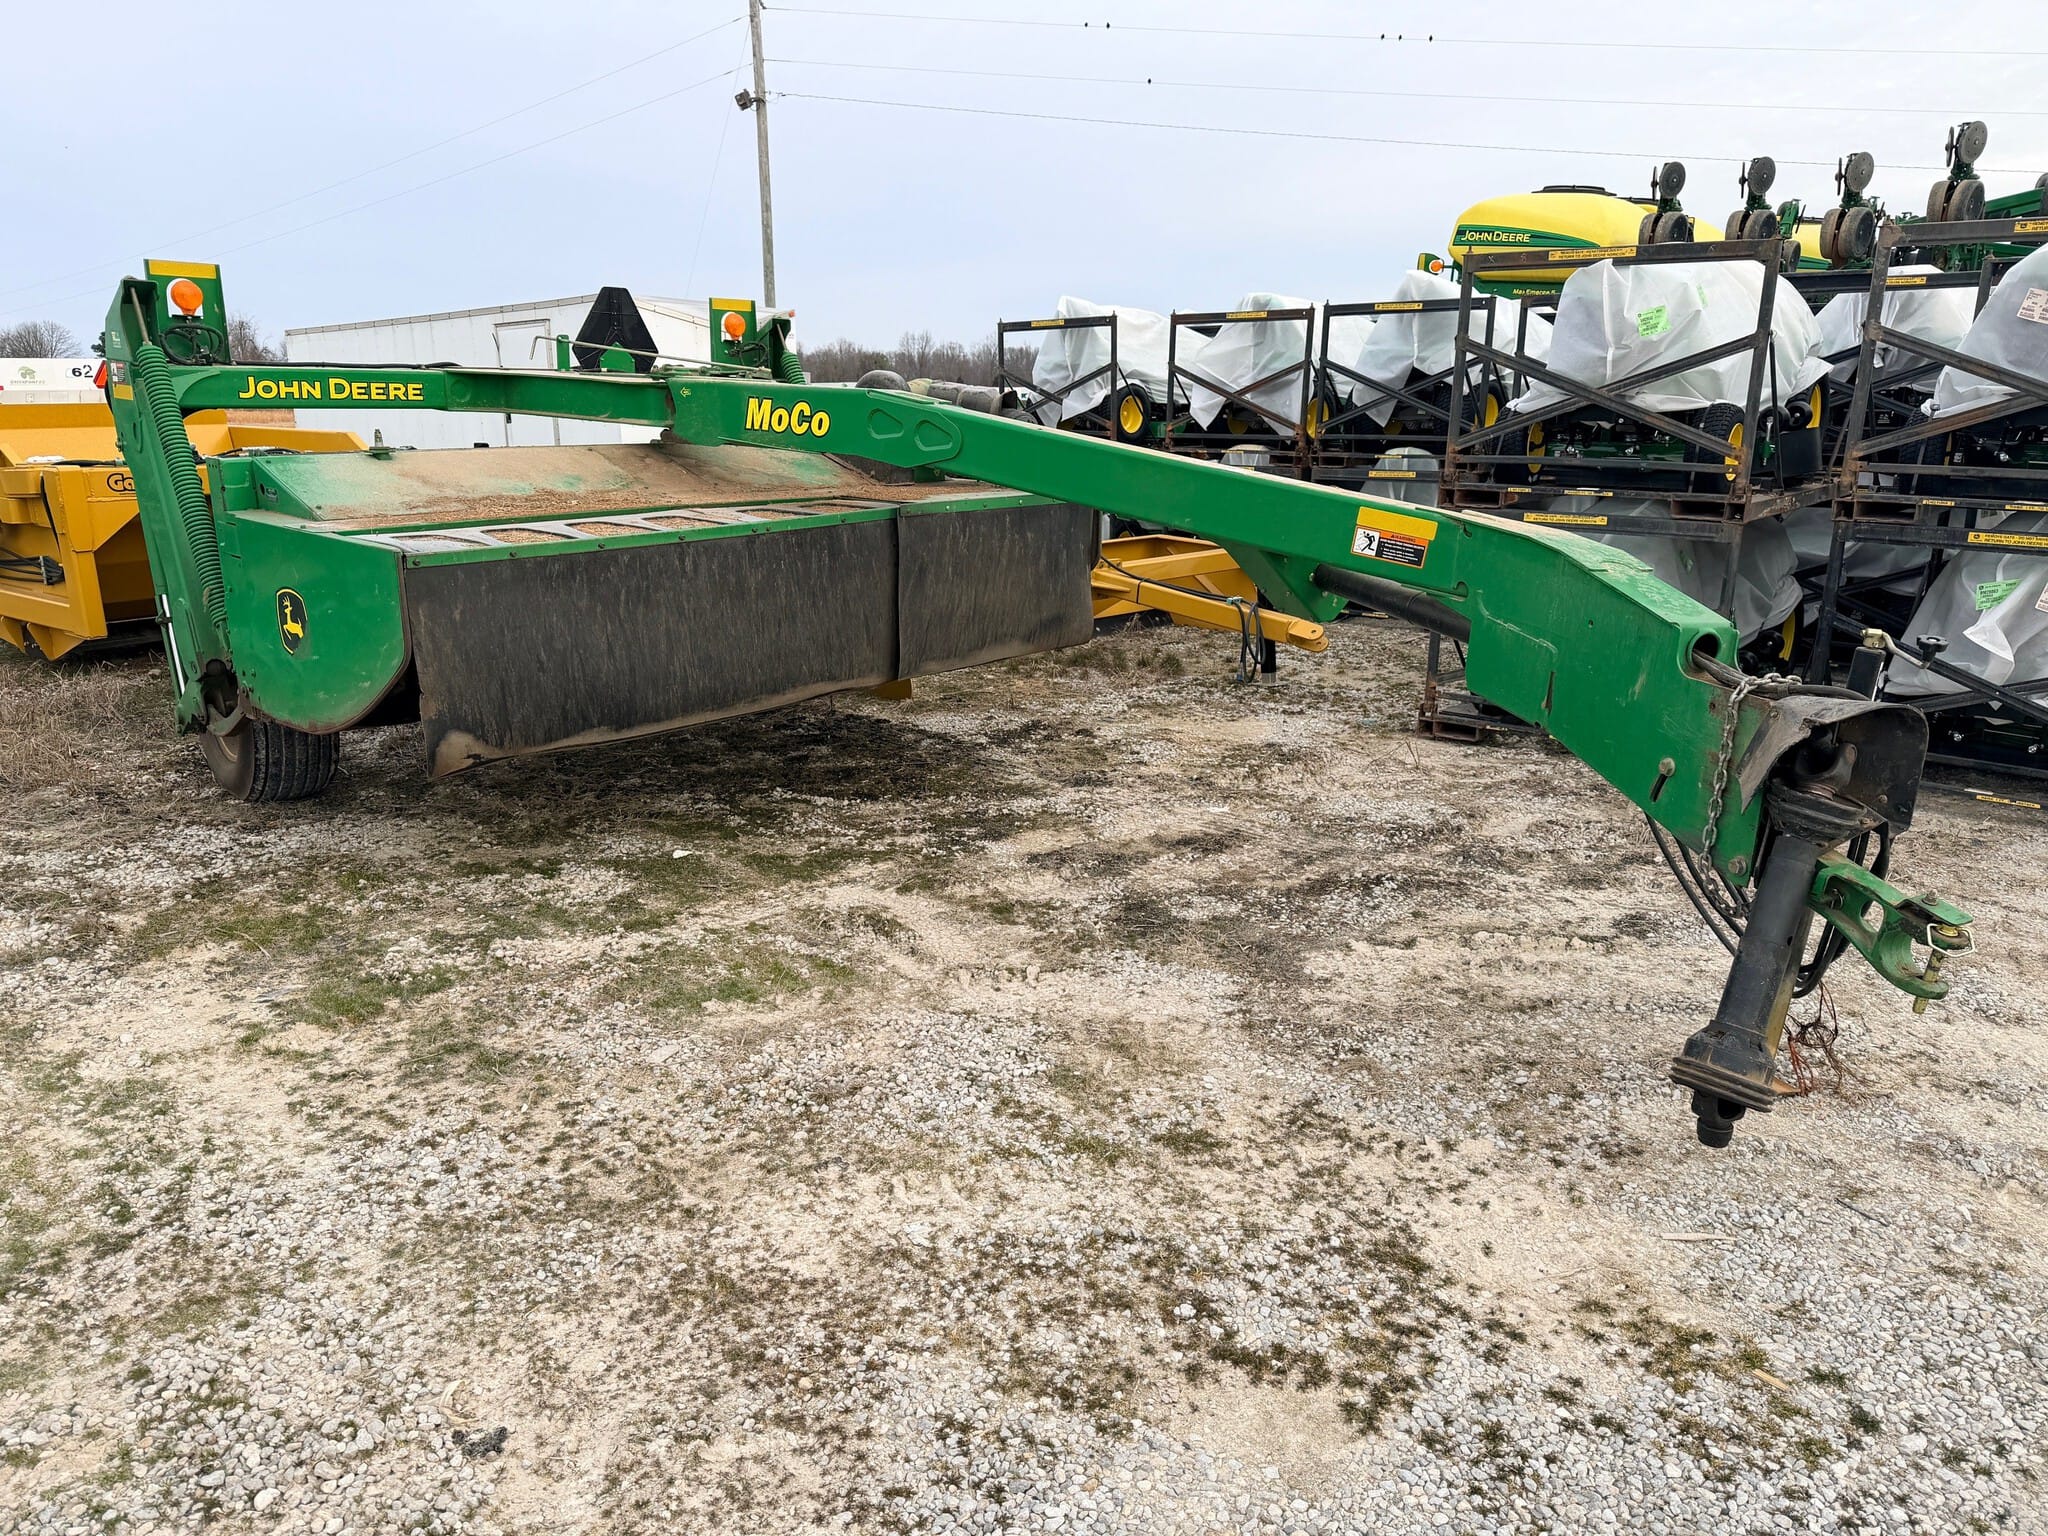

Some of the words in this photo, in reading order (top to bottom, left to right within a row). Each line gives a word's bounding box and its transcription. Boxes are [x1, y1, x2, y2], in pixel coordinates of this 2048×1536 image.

[1461, 230, 1492, 241] JOHN
[1493, 231, 1532, 243] DEERE
[239, 376, 322, 399] JOHN
[328, 377, 424, 401] DEERE
[745, 397, 831, 437] MoCo
